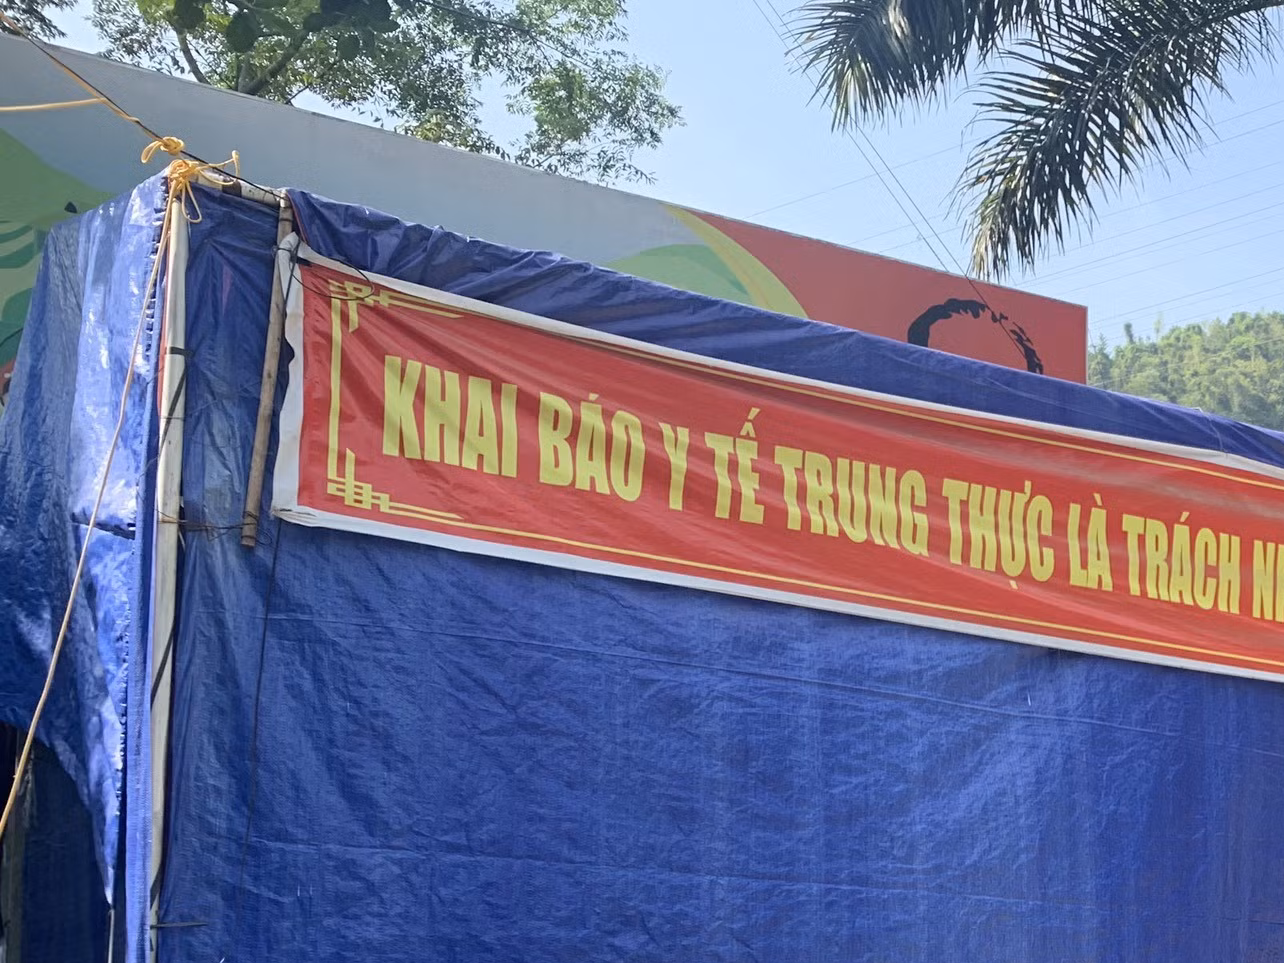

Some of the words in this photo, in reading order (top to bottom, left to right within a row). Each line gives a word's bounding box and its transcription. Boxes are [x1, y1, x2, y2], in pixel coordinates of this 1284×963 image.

[382, 354, 518, 478] KHAI
[538, 393, 646, 502] BÁO
[659, 422, 689, 511] Y
[704, 407, 765, 524] TẾ
[774, 445, 929, 557] TRUNG
[942, 480, 1055, 589] THỰC
[1067, 493, 1113, 592] LÀ
[1122, 512, 1241, 614] TRÁCH
